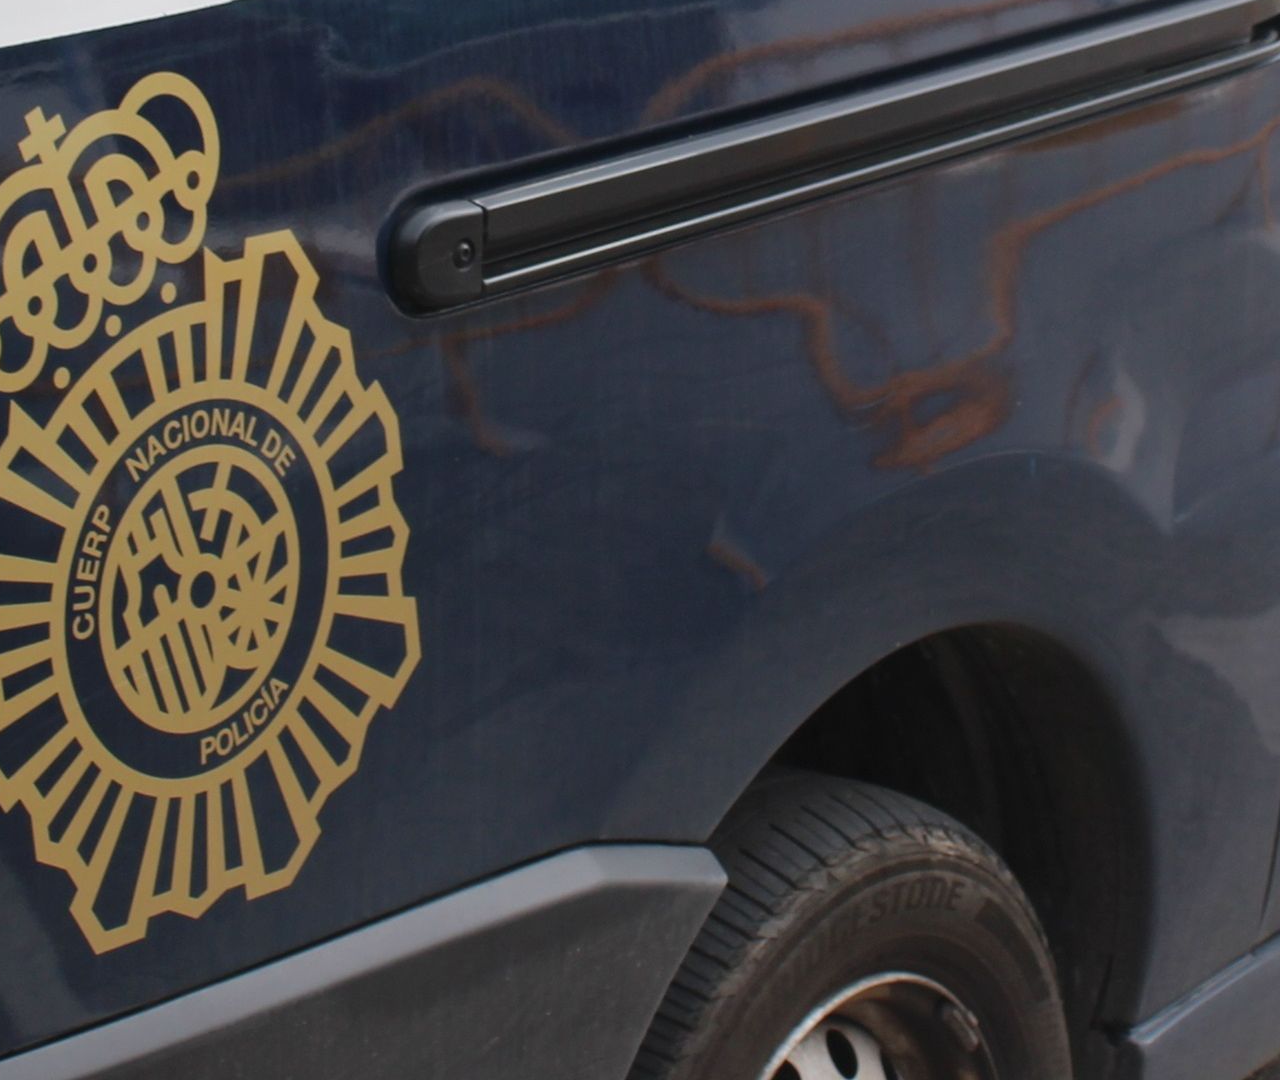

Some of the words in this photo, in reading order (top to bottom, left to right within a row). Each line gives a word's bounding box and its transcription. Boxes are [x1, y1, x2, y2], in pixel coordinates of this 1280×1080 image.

[72, 503, 111, 641] CUERP
[125, 407, 258, 482] NACIONAL
[260, 428, 297, 477] DE
[200, 676, 290, 765] POLICÍA
